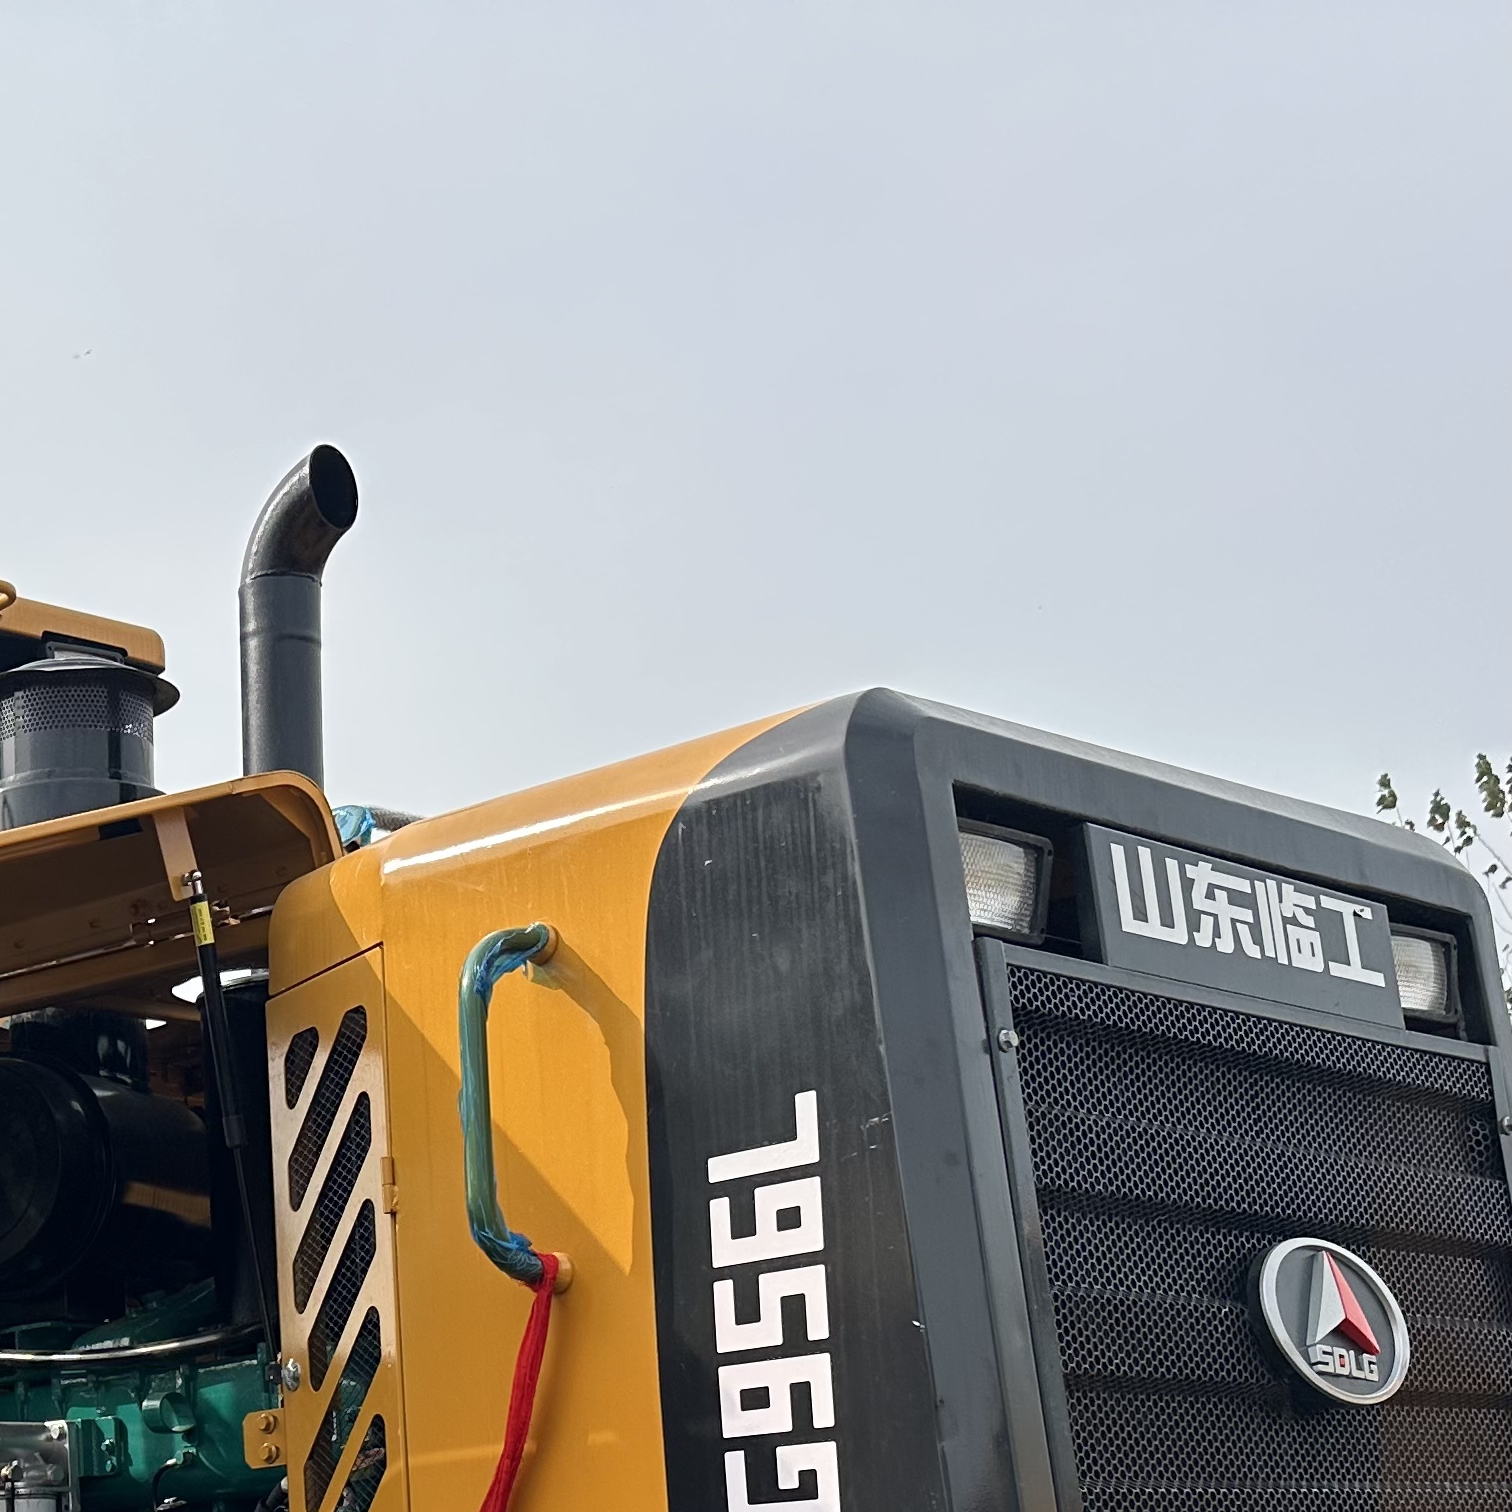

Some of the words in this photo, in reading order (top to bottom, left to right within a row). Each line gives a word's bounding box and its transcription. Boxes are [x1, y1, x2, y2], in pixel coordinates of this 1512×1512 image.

[1109, 842, 1386, 988] 山东临工
[1308, 1344, 1379, 1382] SDLG
